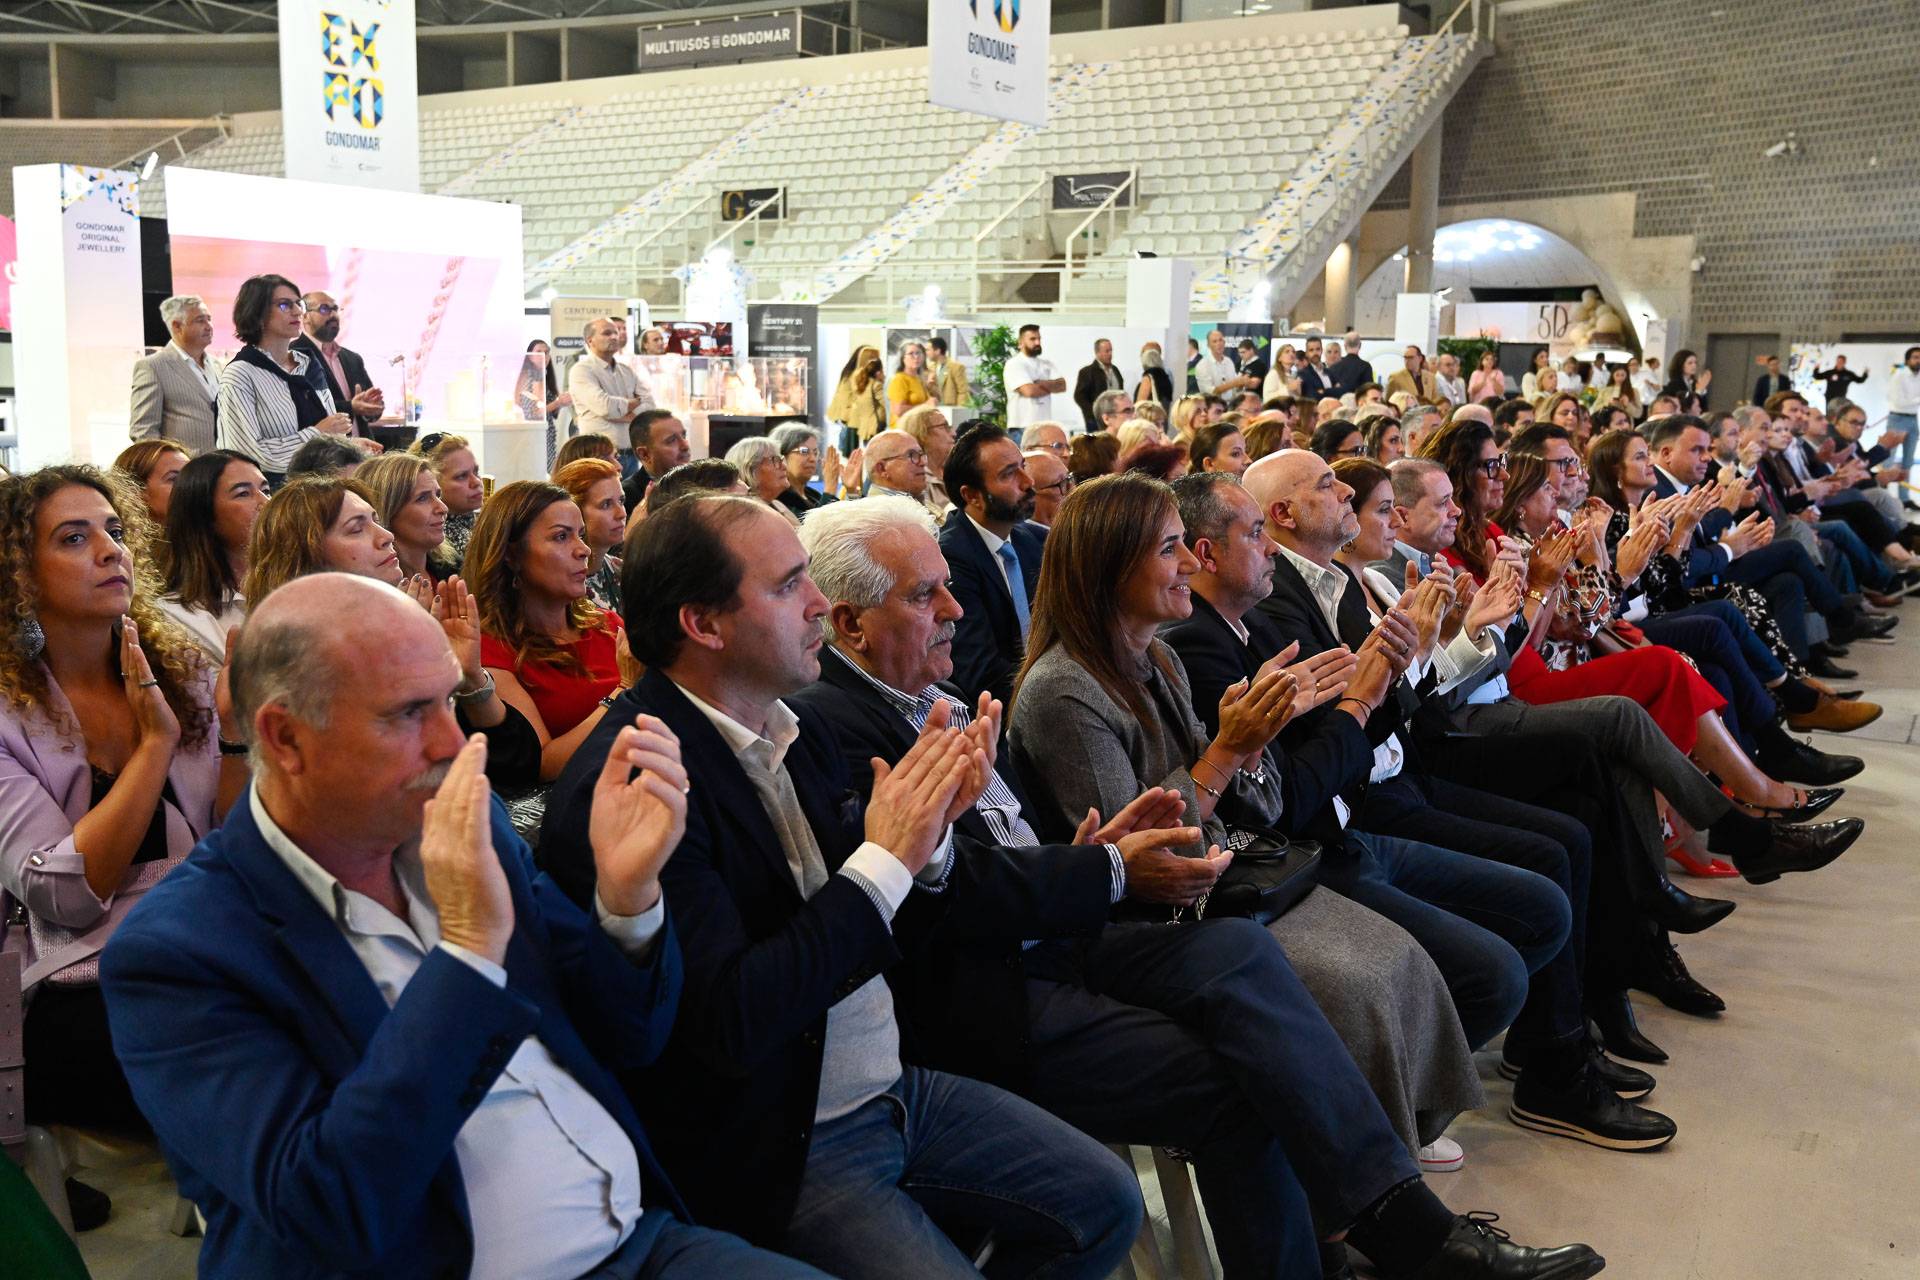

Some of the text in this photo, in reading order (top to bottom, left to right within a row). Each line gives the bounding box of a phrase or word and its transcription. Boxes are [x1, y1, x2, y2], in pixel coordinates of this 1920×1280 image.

[320, 11, 381, 72] EX
[645, 36, 711, 55] MULTIUSOS
[722, 28, 791, 47] GONDOMAR
[968, 32, 1017, 65] GONDOMAR
[323, 71, 384, 129] PO
[325, 131, 381, 151] GONDOMAR
[75, 222, 125, 232] GONDOMAR
[81, 233, 120, 242] ORIGINAL
[77, 244, 126, 253] JEWELLERY
[564, 307, 603, 315] CENTURY
